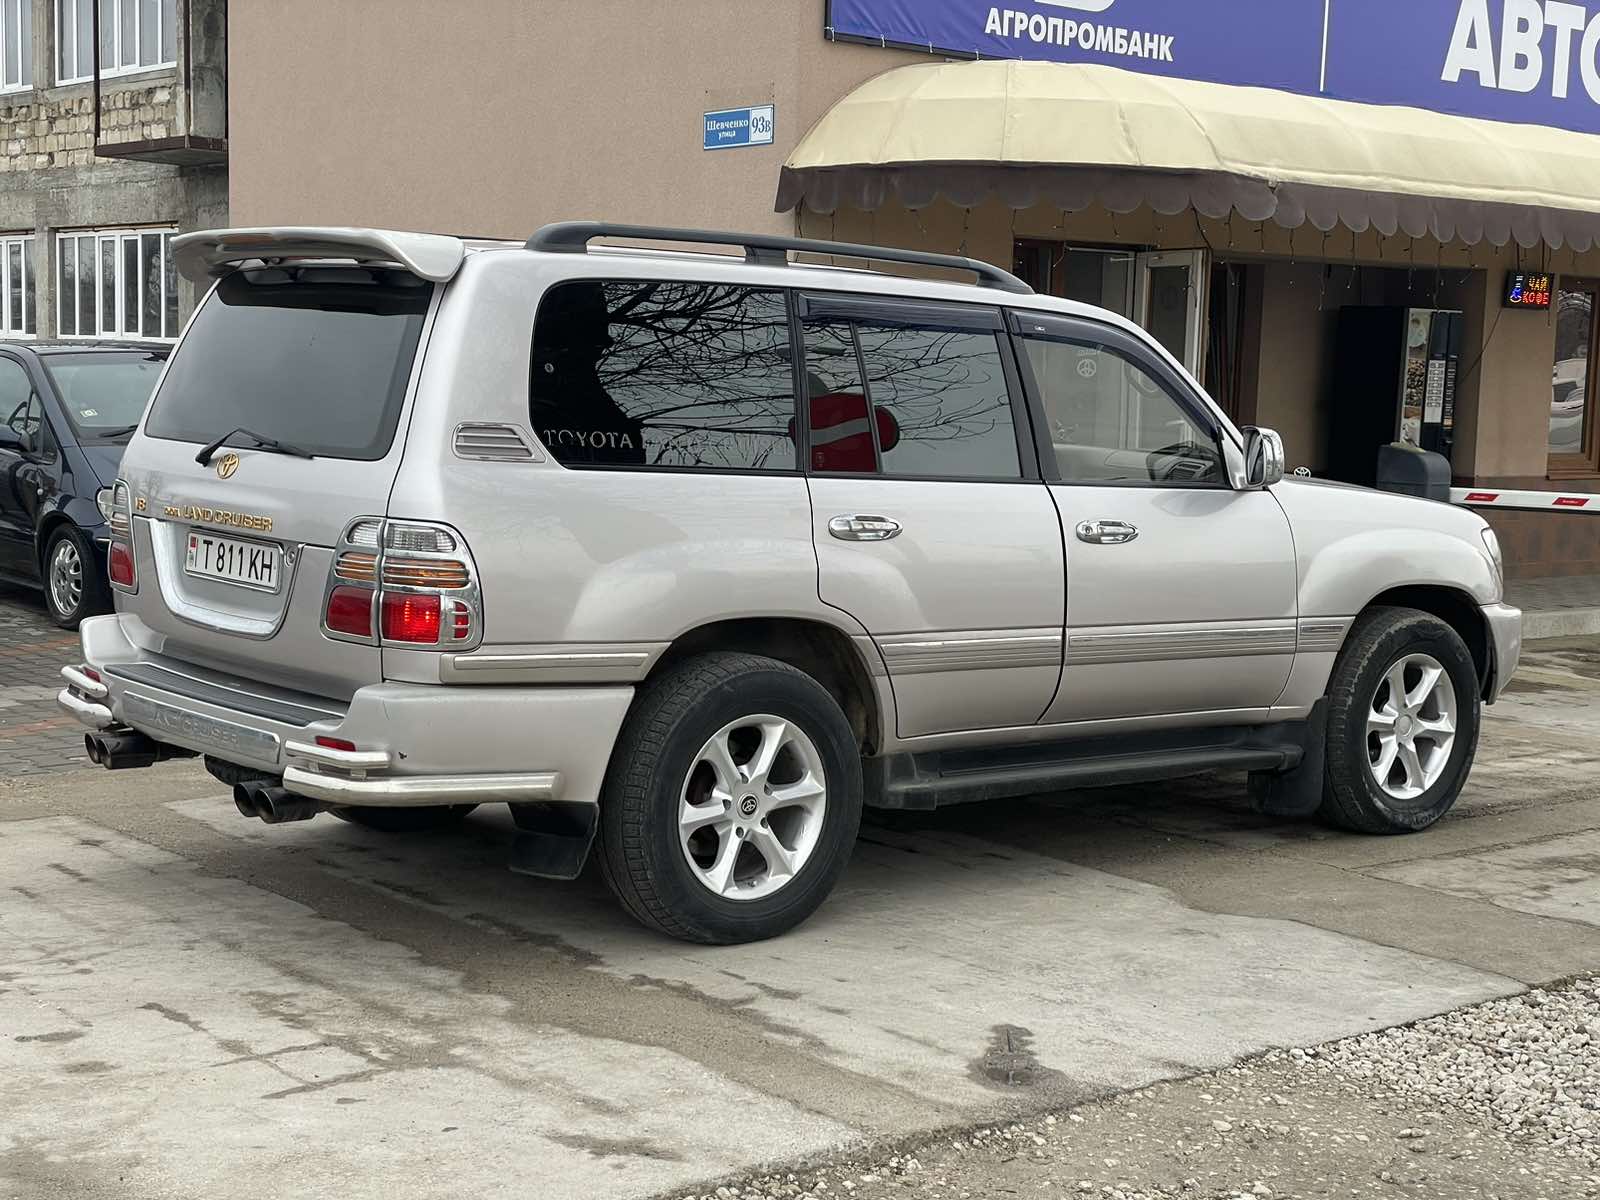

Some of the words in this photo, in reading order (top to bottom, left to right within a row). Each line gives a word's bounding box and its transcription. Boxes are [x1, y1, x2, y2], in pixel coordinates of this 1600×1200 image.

[985, 7, 1174, 62] АГРОПРОМБАНК
[706, 119, 749, 131] Шевченко
[718, 130, 736, 141] улица
[1528, 275, 1548, 291] ЧАЙ
[1522, 291, 1549, 305] КОФЕ
[543, 429, 633, 449] TOYOTA
[183, 505, 214, 521] LAND
[214, 508, 273, 532] CRUISER
